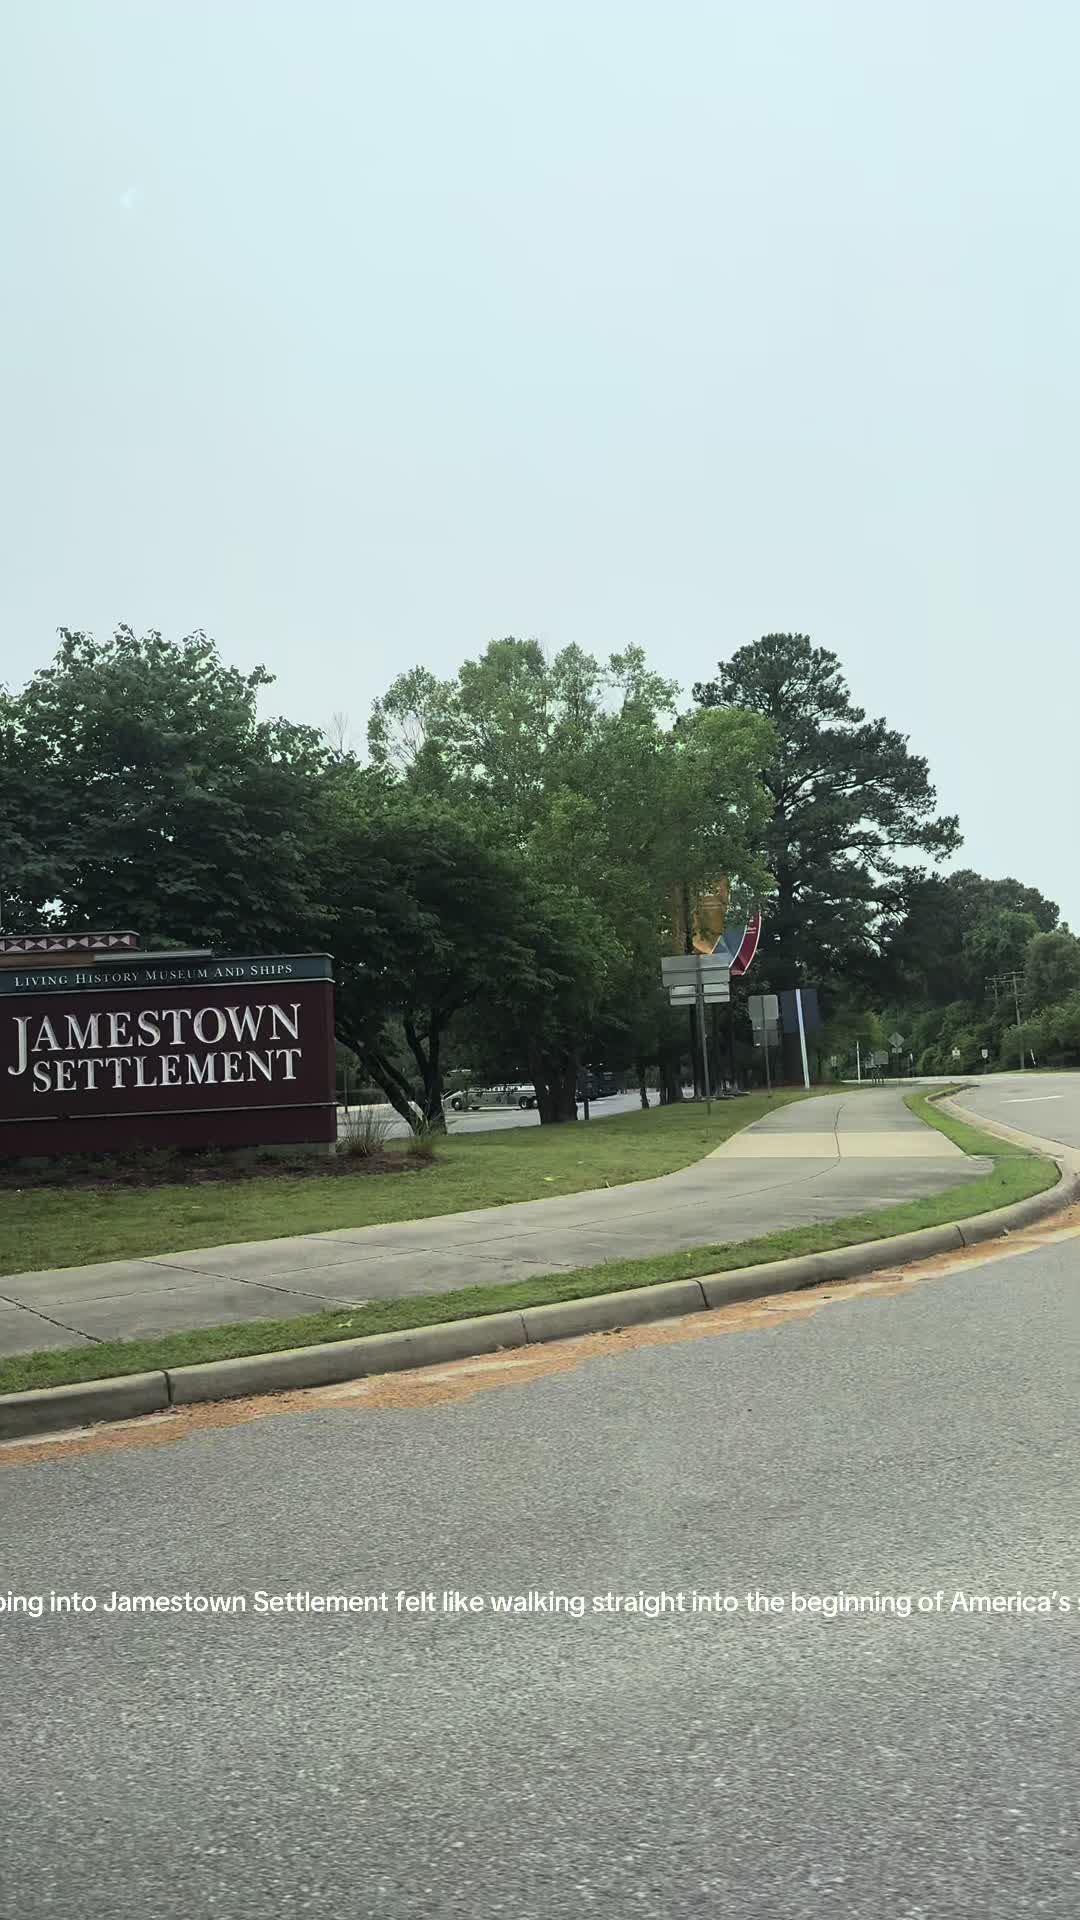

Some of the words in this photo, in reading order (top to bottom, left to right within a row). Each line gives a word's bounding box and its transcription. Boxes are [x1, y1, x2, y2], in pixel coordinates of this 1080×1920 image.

[15, 975, 68, 987] LIVING
[76, 972, 140, 984] HISTORY
[146, 968, 208, 980] MUSEUM
[214, 966, 245, 978] AND
[250, 964, 293, 976] SHIPS
[8, 1003, 301, 1076] JAMESTOWN
[33, 1048, 302, 1093] SETTLEMENT
